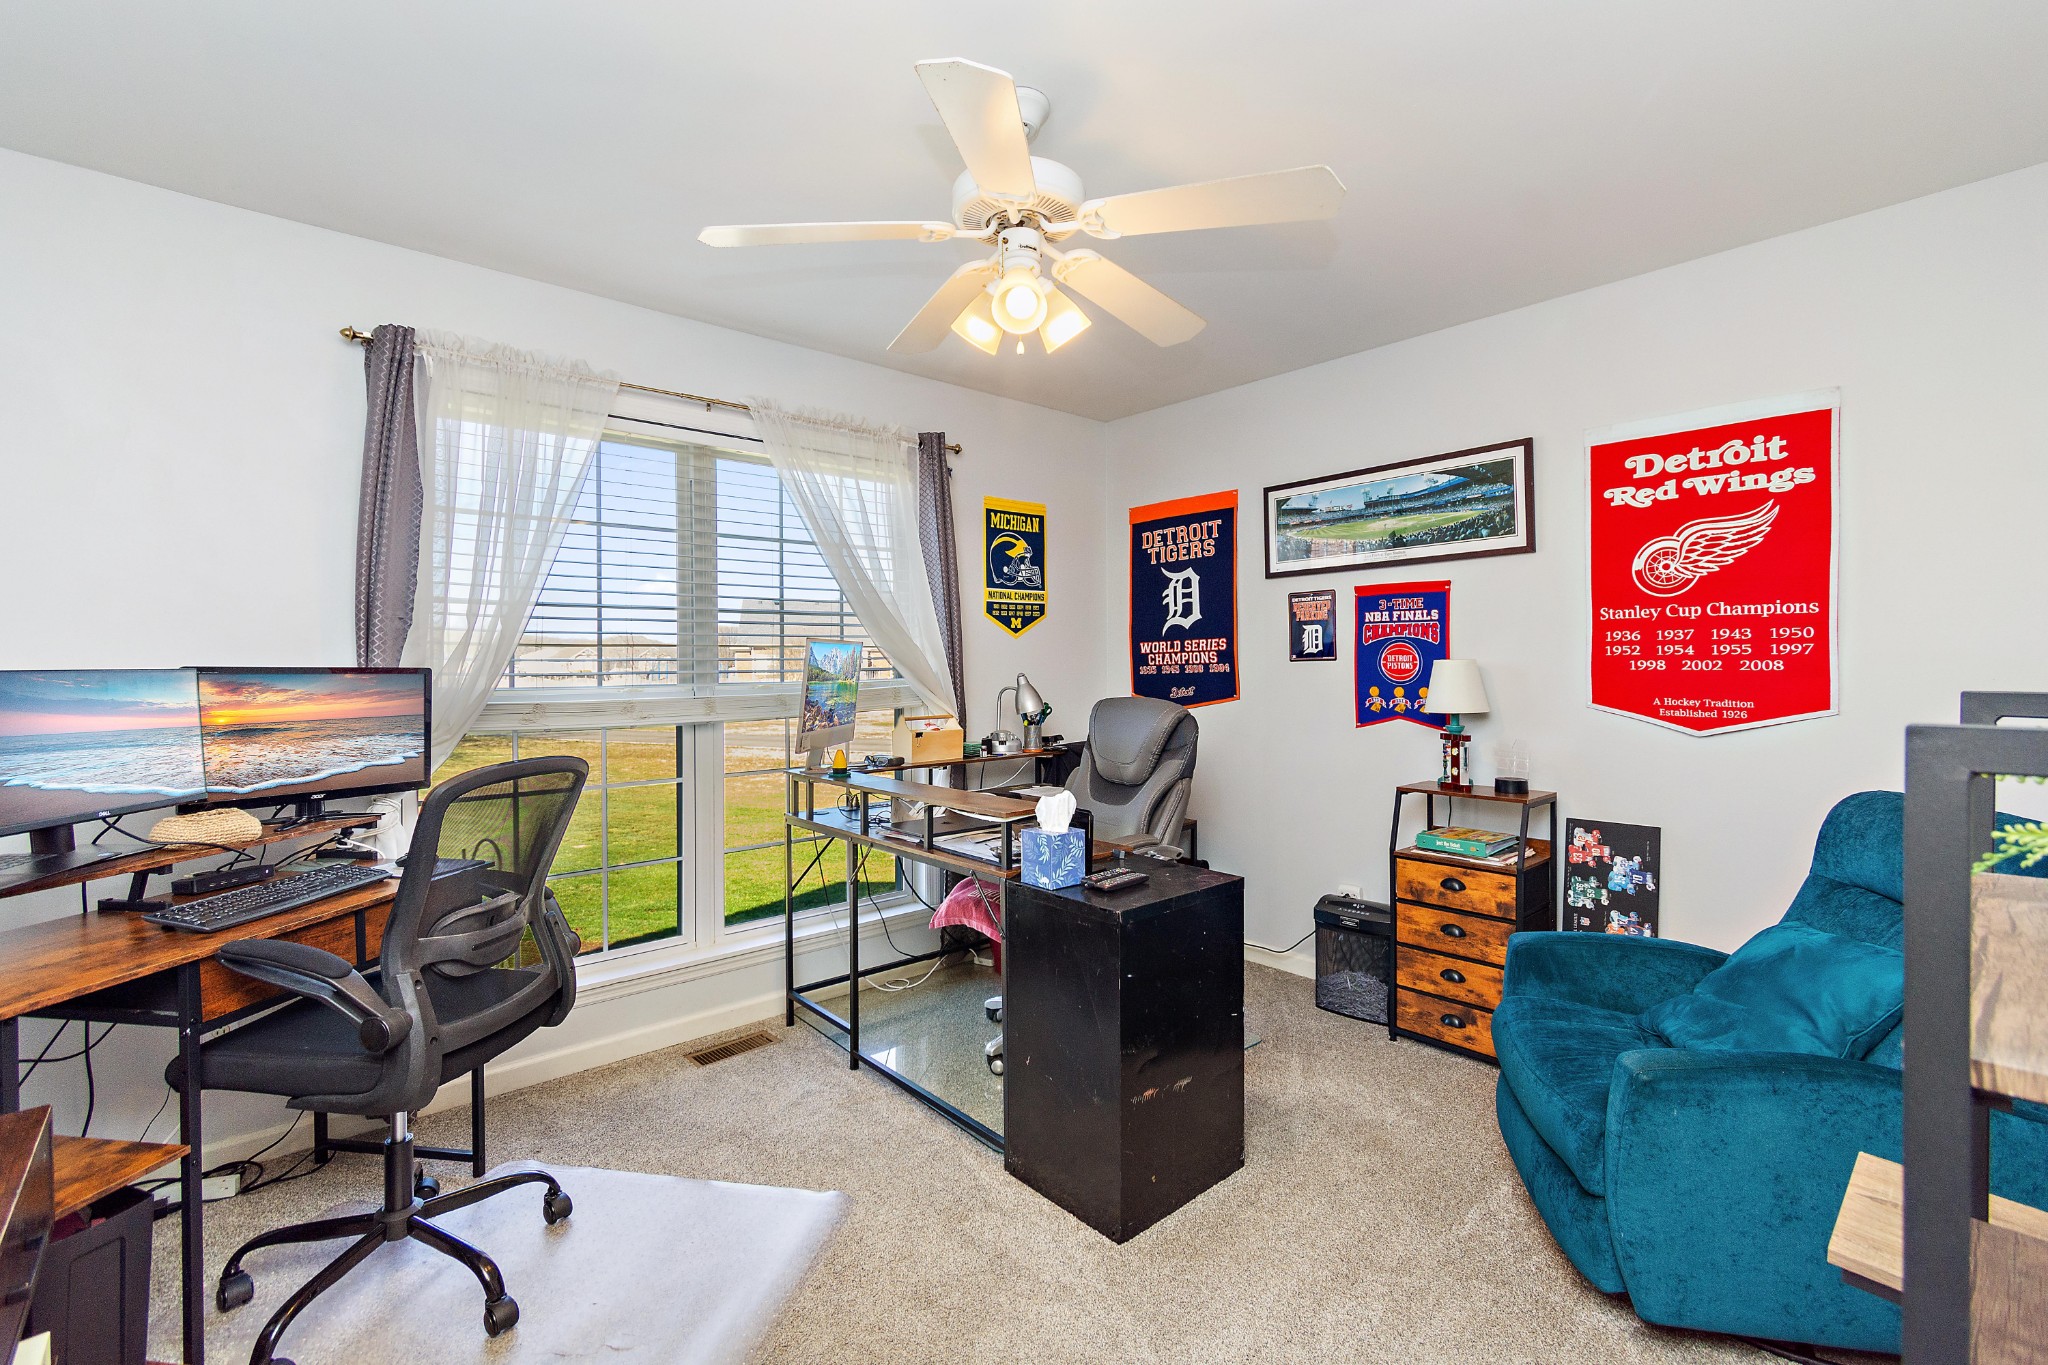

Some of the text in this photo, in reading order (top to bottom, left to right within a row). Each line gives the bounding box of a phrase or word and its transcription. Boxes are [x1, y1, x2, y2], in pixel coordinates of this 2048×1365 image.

[1625, 435, 1789, 479] Detroit
[1604, 467, 1816, 508] Red Wings
[990, 512, 1040, 533] MICHIGAN
[1142, 519, 1222, 549] DETROIT
[1147, 539, 1216, 565] TIGERS
[988, 590, 1045, 602] NATIONAL CHAMPIONS
[1379, 598, 1424, 610] 3-TIME
[1600, 600, 1820, 621] Stanley Cup Champions
[1010, 617, 1022, 629] M
[1365, 609, 1439, 622] NBA FINALS
[1363, 622, 1440, 645] CHAMPIONS
[1605, 626, 1815, 642] 1936 1937 1943 1950
[1140, 638, 1227, 654] WORLD SERIES
[1605, 643, 1815, 656] 1952 1954 1955 1997
[1148, 651, 1218, 666] CHAMPIONS
[1387, 662, 1413, 670] PISTONS
[1629, 660, 1785, 671] 1998 2002 2008
[1653, 697, 1755, 709] A Hockey Tradition
[1659, 708, 1748, 719] Established 1926
